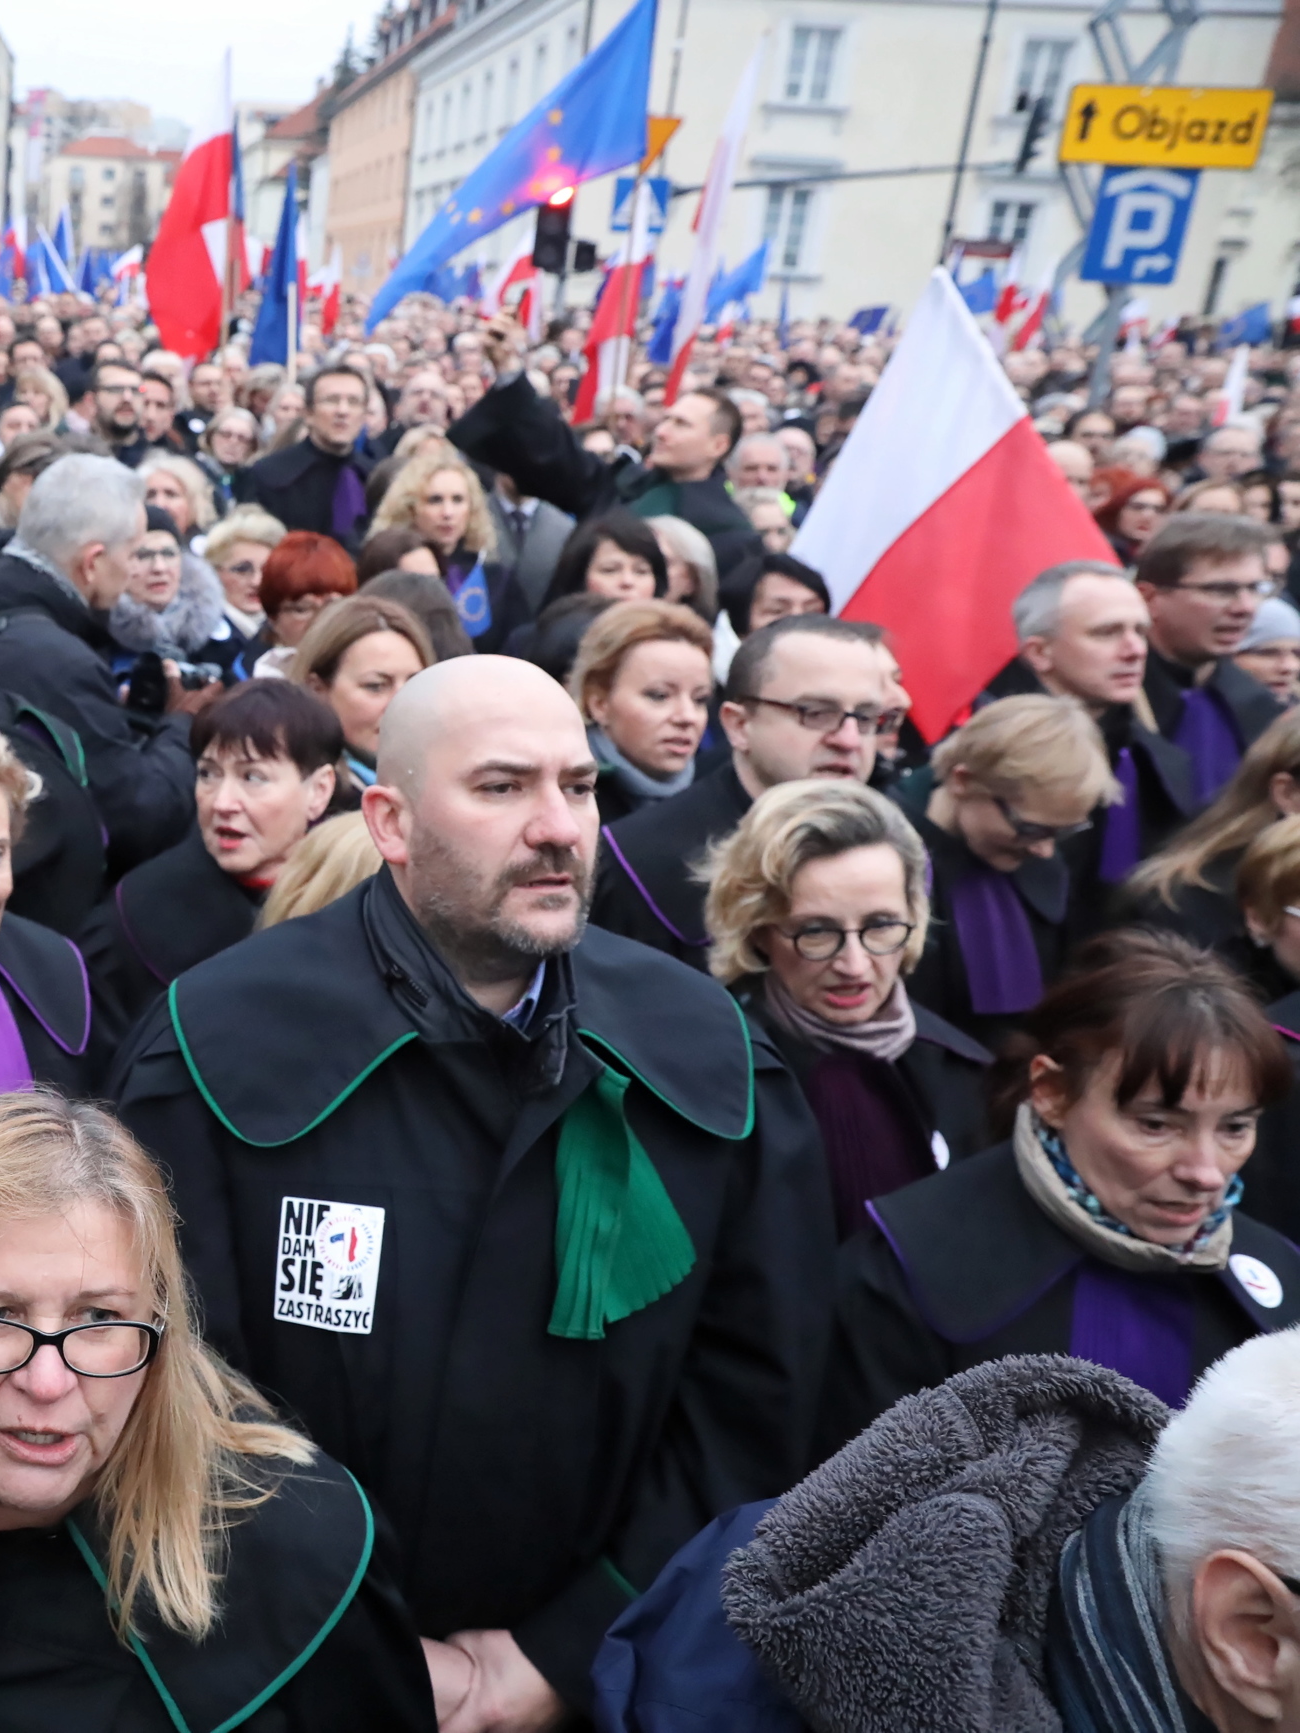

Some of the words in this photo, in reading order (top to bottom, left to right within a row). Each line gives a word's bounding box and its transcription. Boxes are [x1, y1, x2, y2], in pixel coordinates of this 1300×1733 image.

[1111, 103, 1259, 152] Objazd
[1102, 193, 1175, 269] P
[282, 1237, 315, 1258] DAM
[280, 1258, 324, 1300] SIĘ
[277, 1298, 370, 1329] ZASTRASZYĆ
